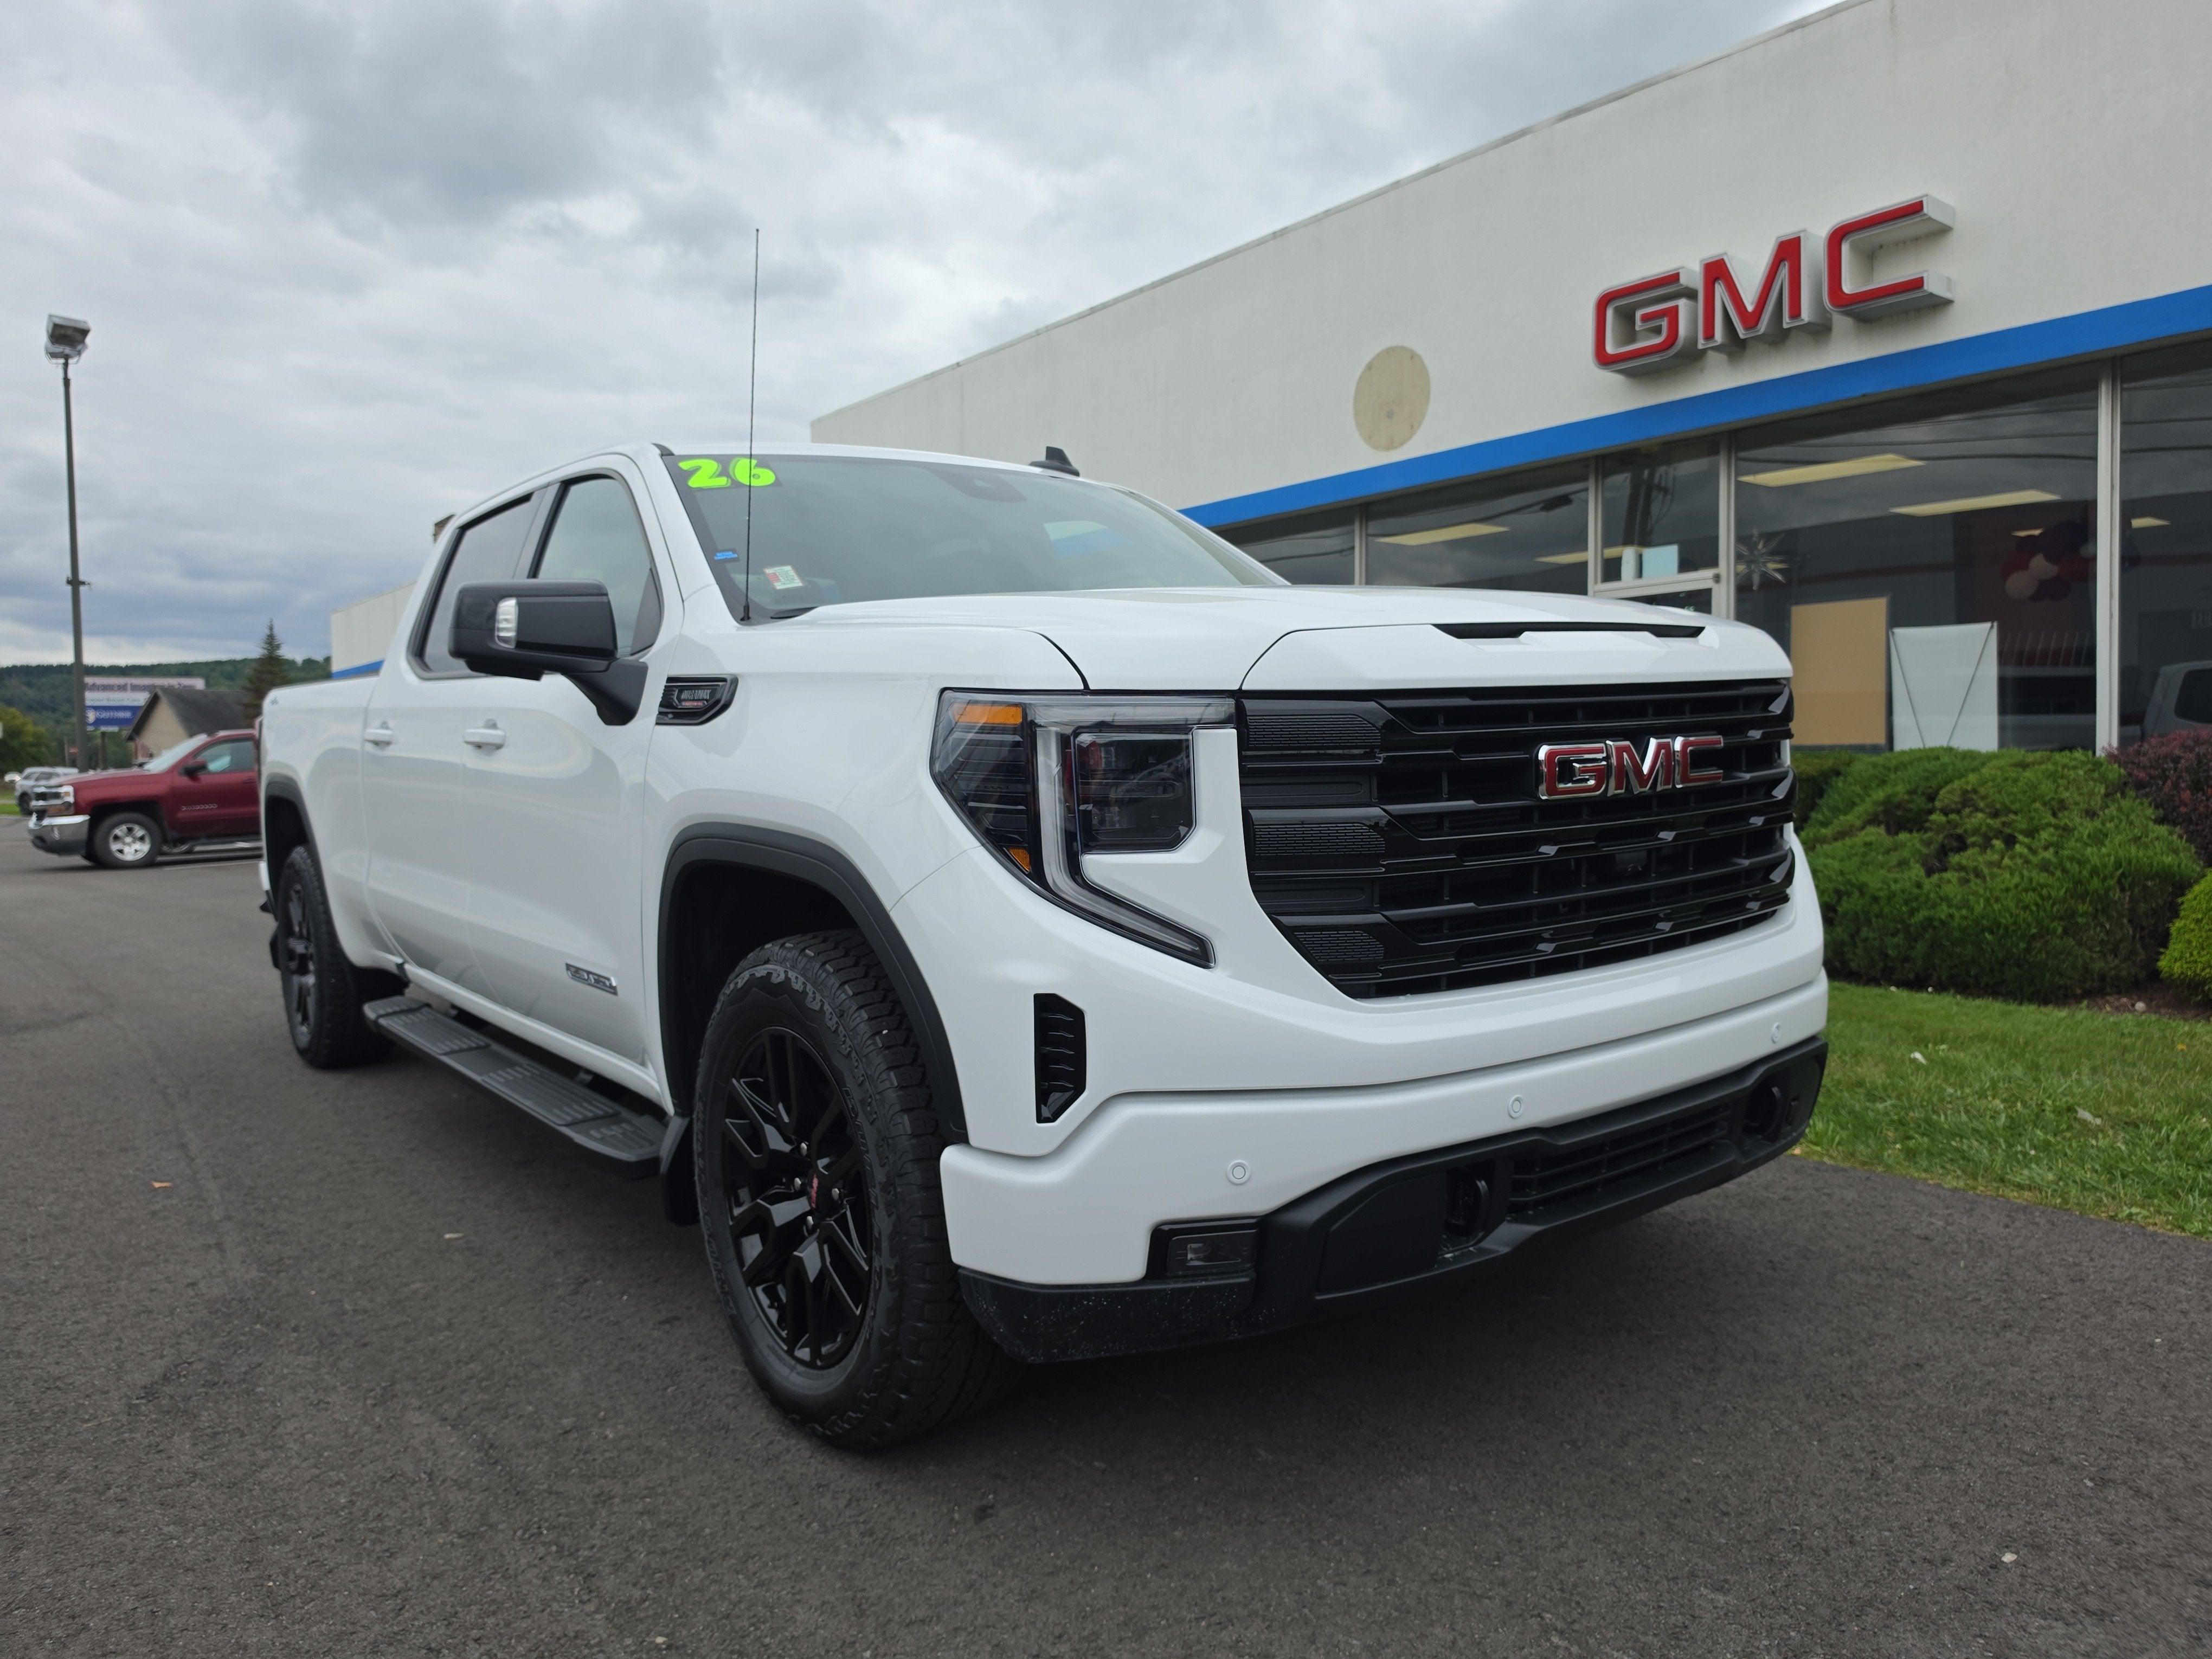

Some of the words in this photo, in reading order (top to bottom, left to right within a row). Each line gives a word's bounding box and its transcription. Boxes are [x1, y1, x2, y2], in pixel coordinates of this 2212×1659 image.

[1592, 194, 1954, 374] GMC
[678, 456, 776, 488] 26
[1538, 735, 1724, 800] GMC
